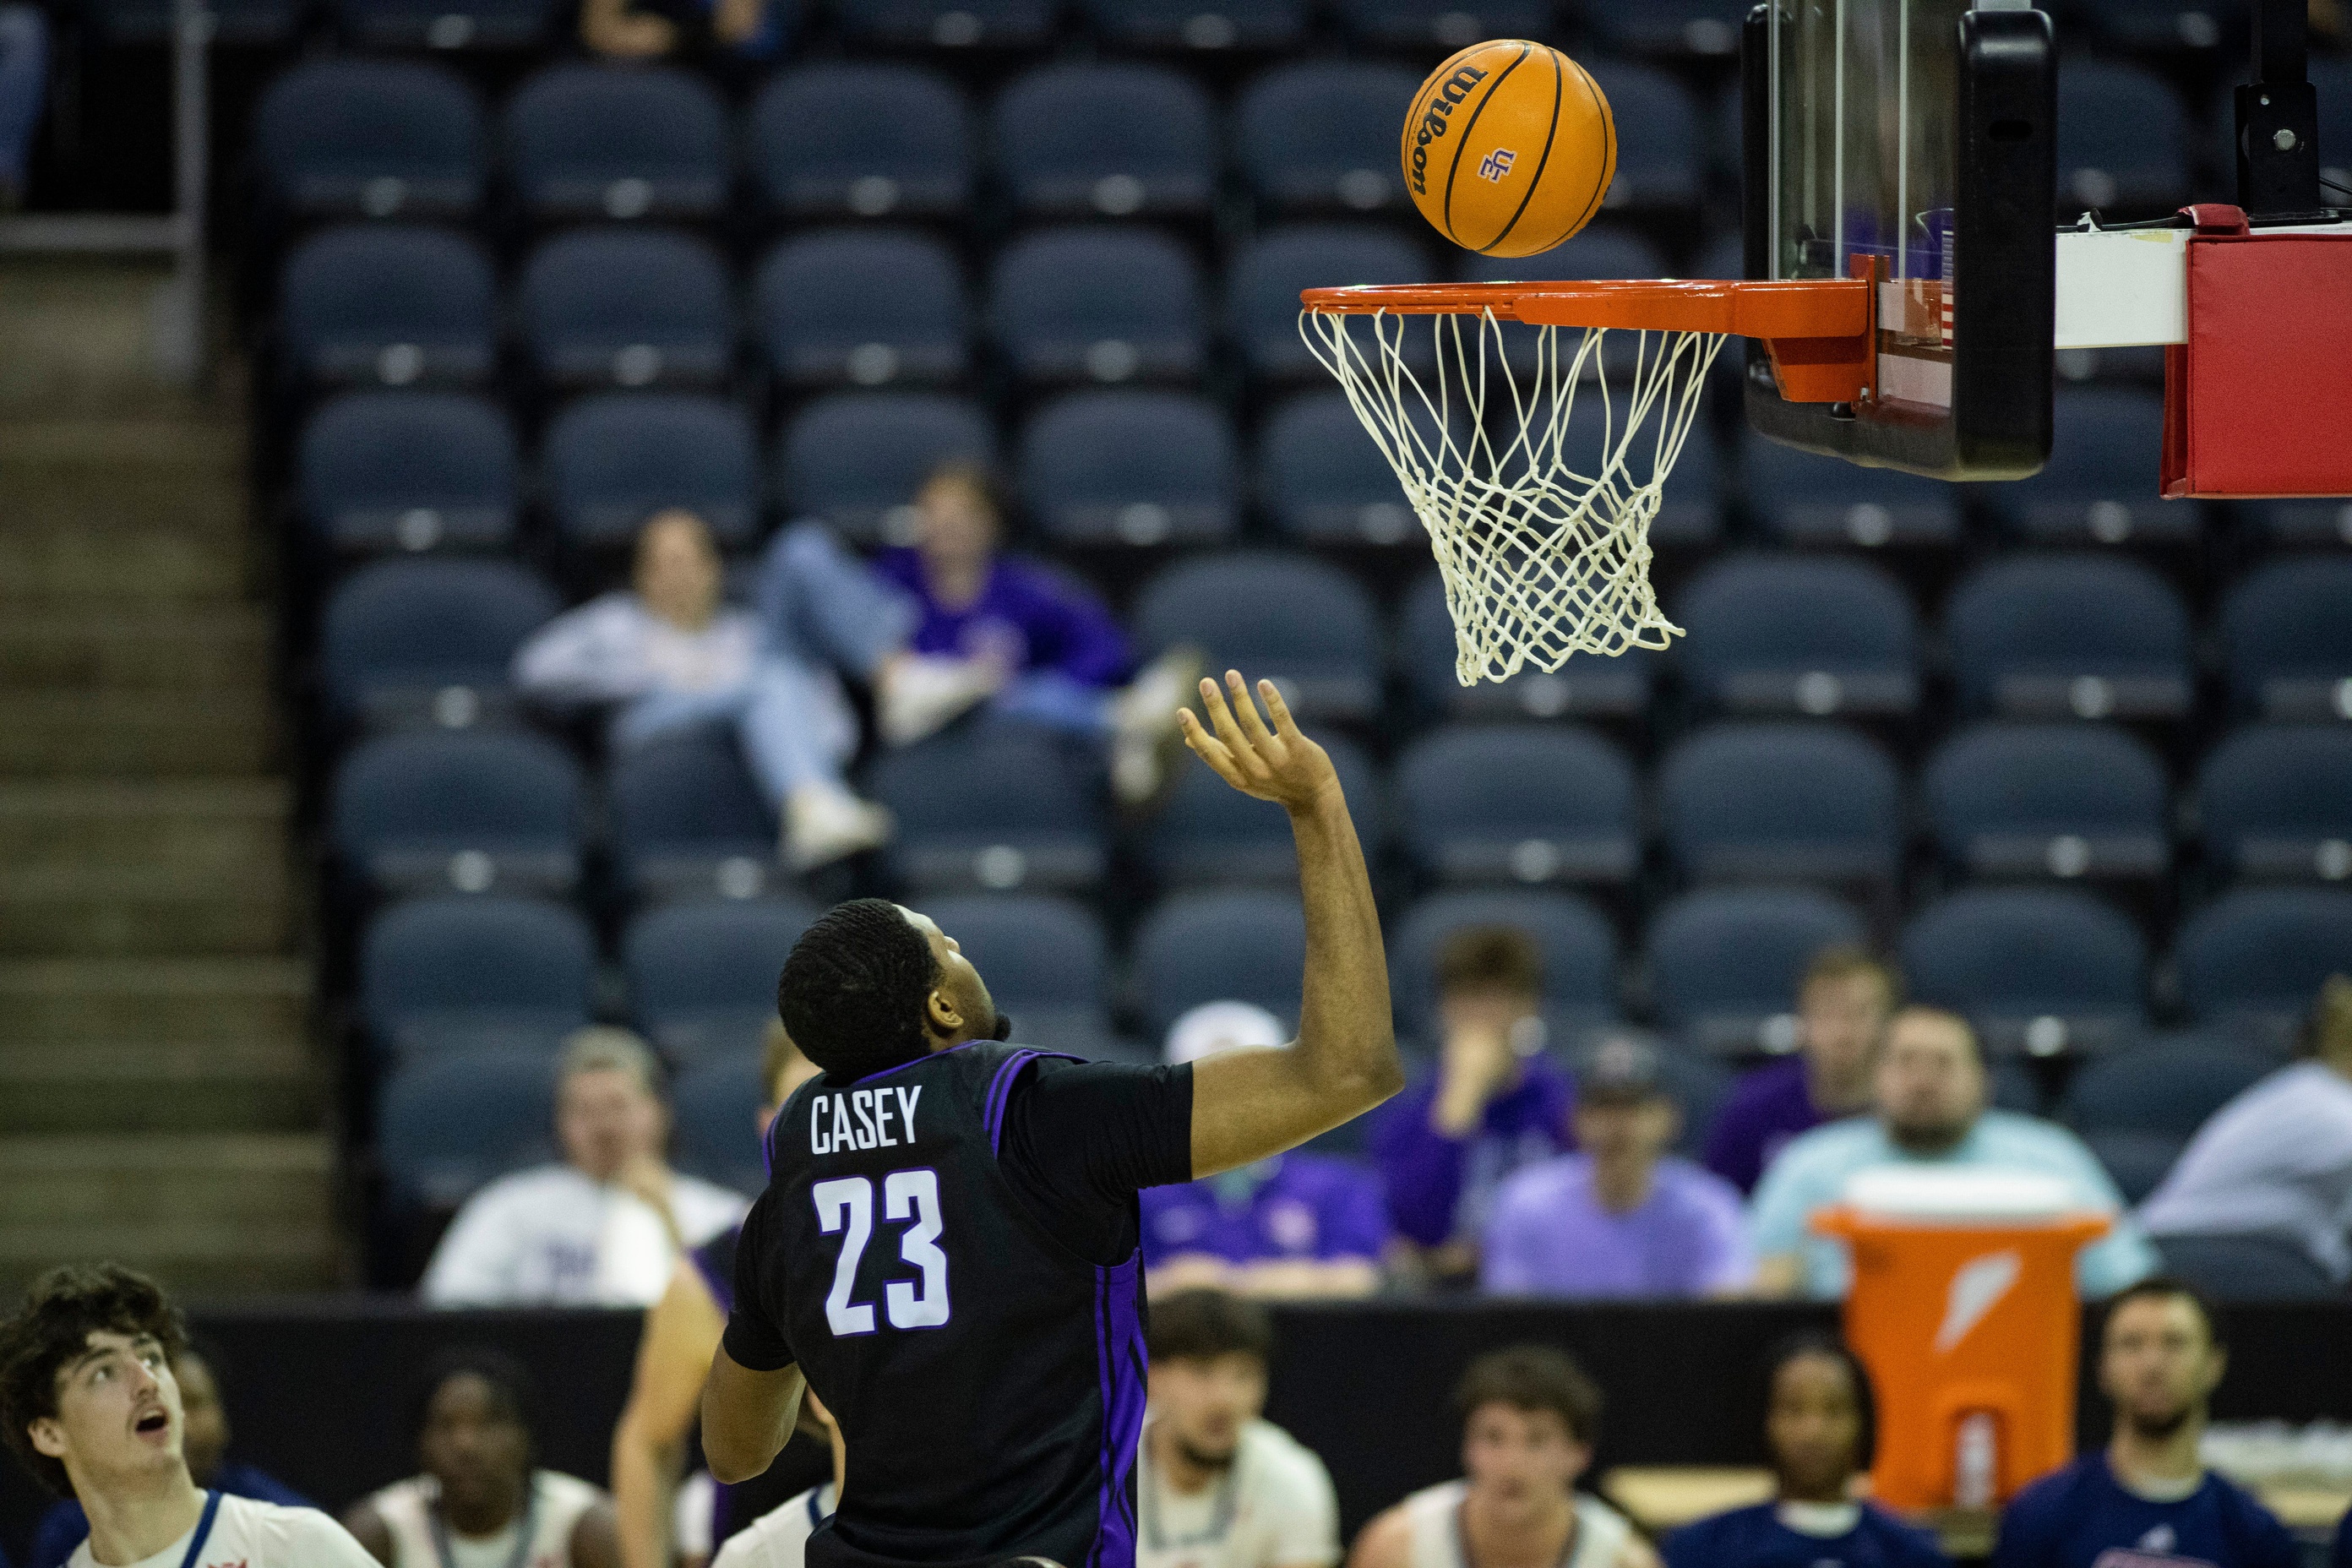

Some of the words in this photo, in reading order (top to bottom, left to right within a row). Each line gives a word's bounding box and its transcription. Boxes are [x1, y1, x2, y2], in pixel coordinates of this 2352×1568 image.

[1413, 65, 1489, 195] Wilson
[811, 1085, 922, 1154] CASEY
[812, 1167, 952, 1337] 23
